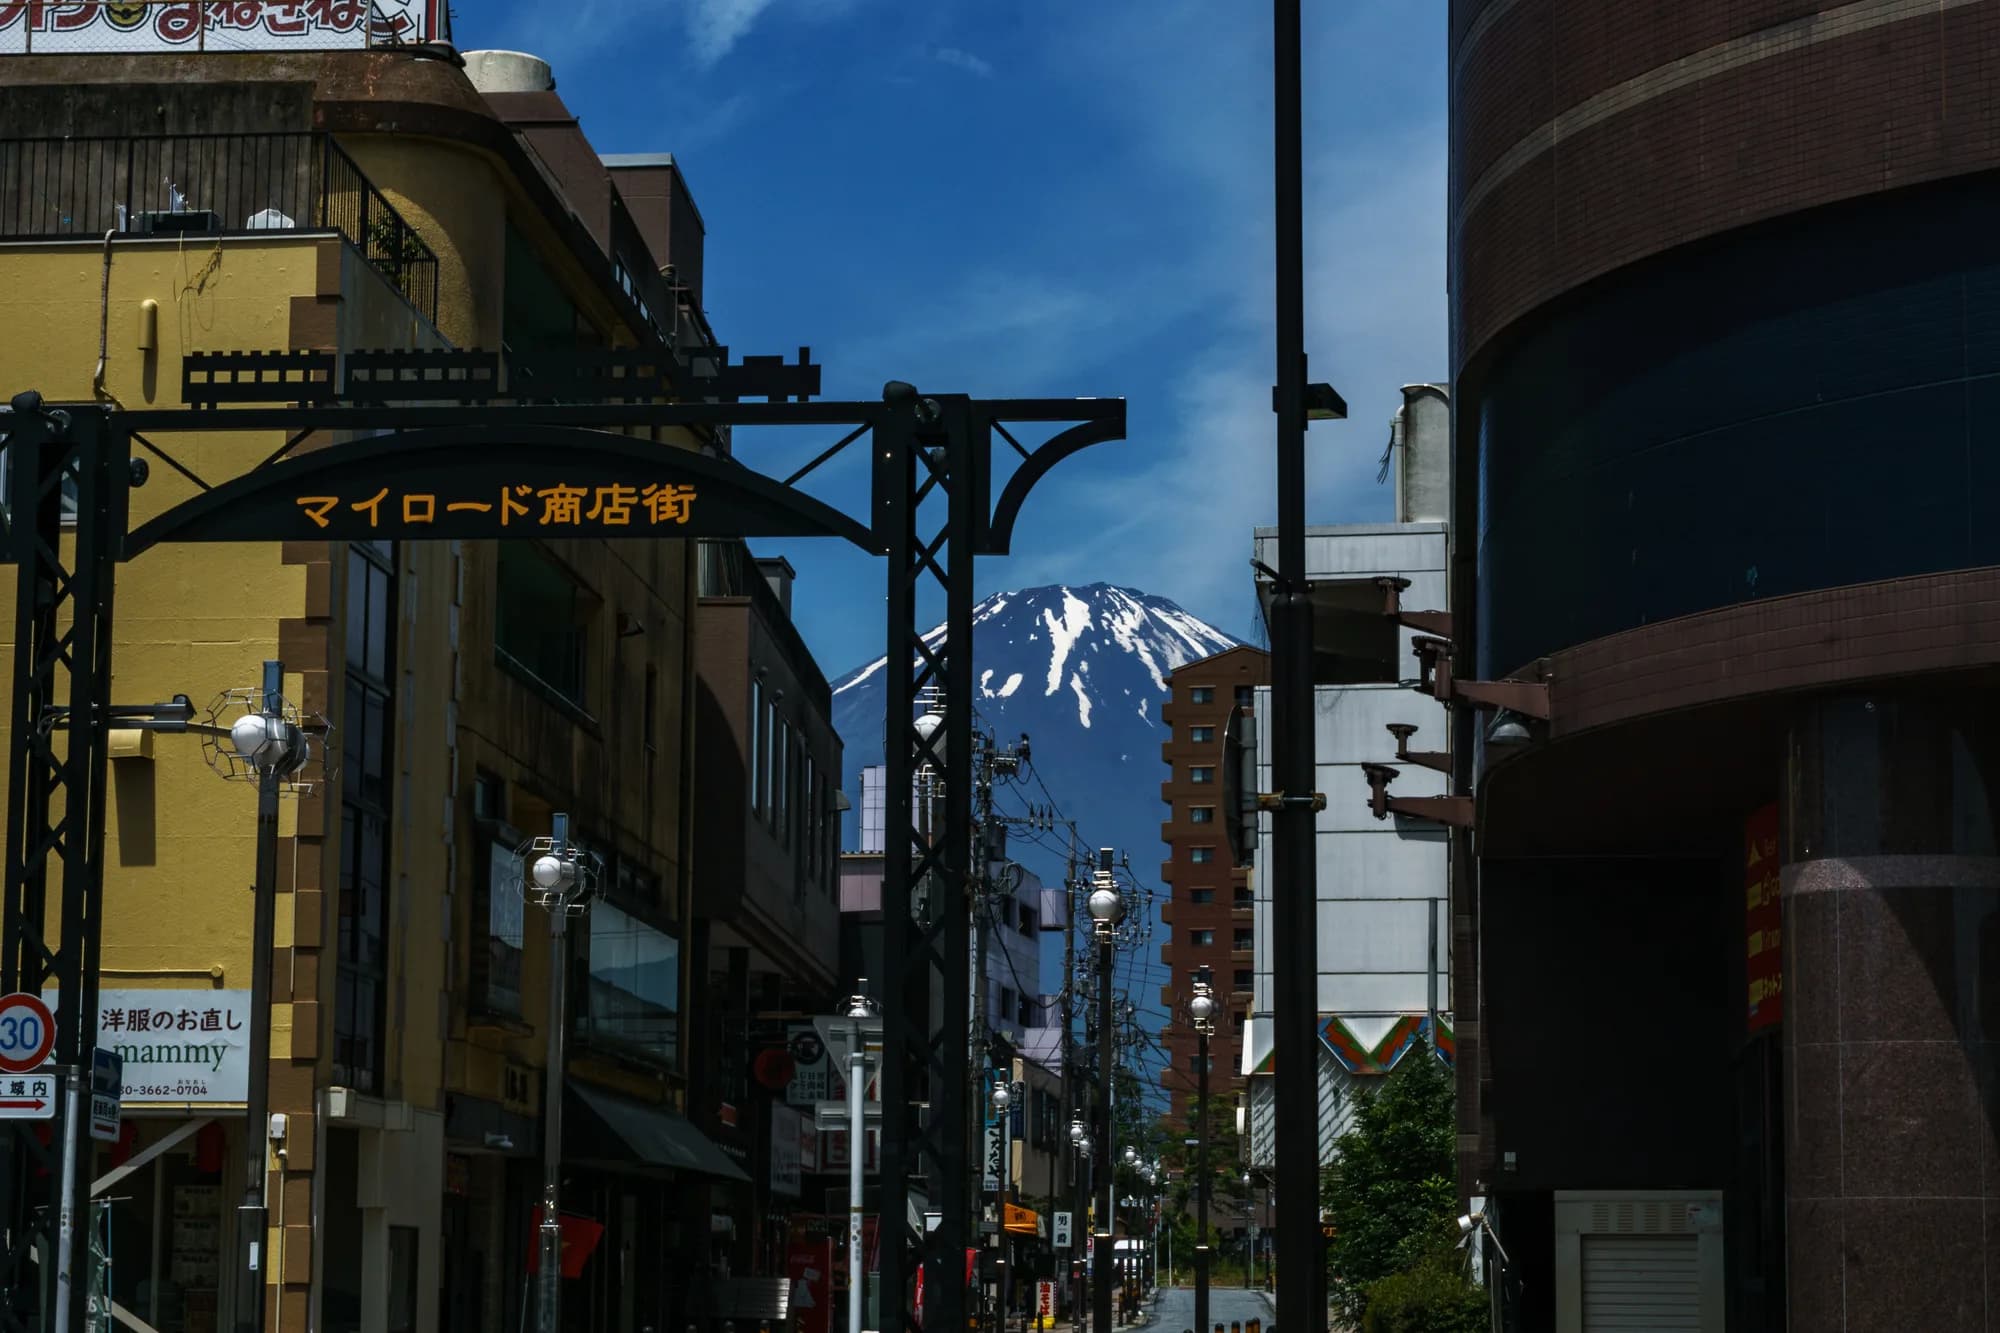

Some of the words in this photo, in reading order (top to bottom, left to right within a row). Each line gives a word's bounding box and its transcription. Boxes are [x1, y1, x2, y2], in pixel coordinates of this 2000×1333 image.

[296, 482, 698, 528] マイロード商店街
[0, 1017, 39, 1050] 30
[101, 1008, 242, 1032] 洋服のお直し
[113, 1043, 228, 1072] mammy
[0, 1080, 47, 1096] 域内
